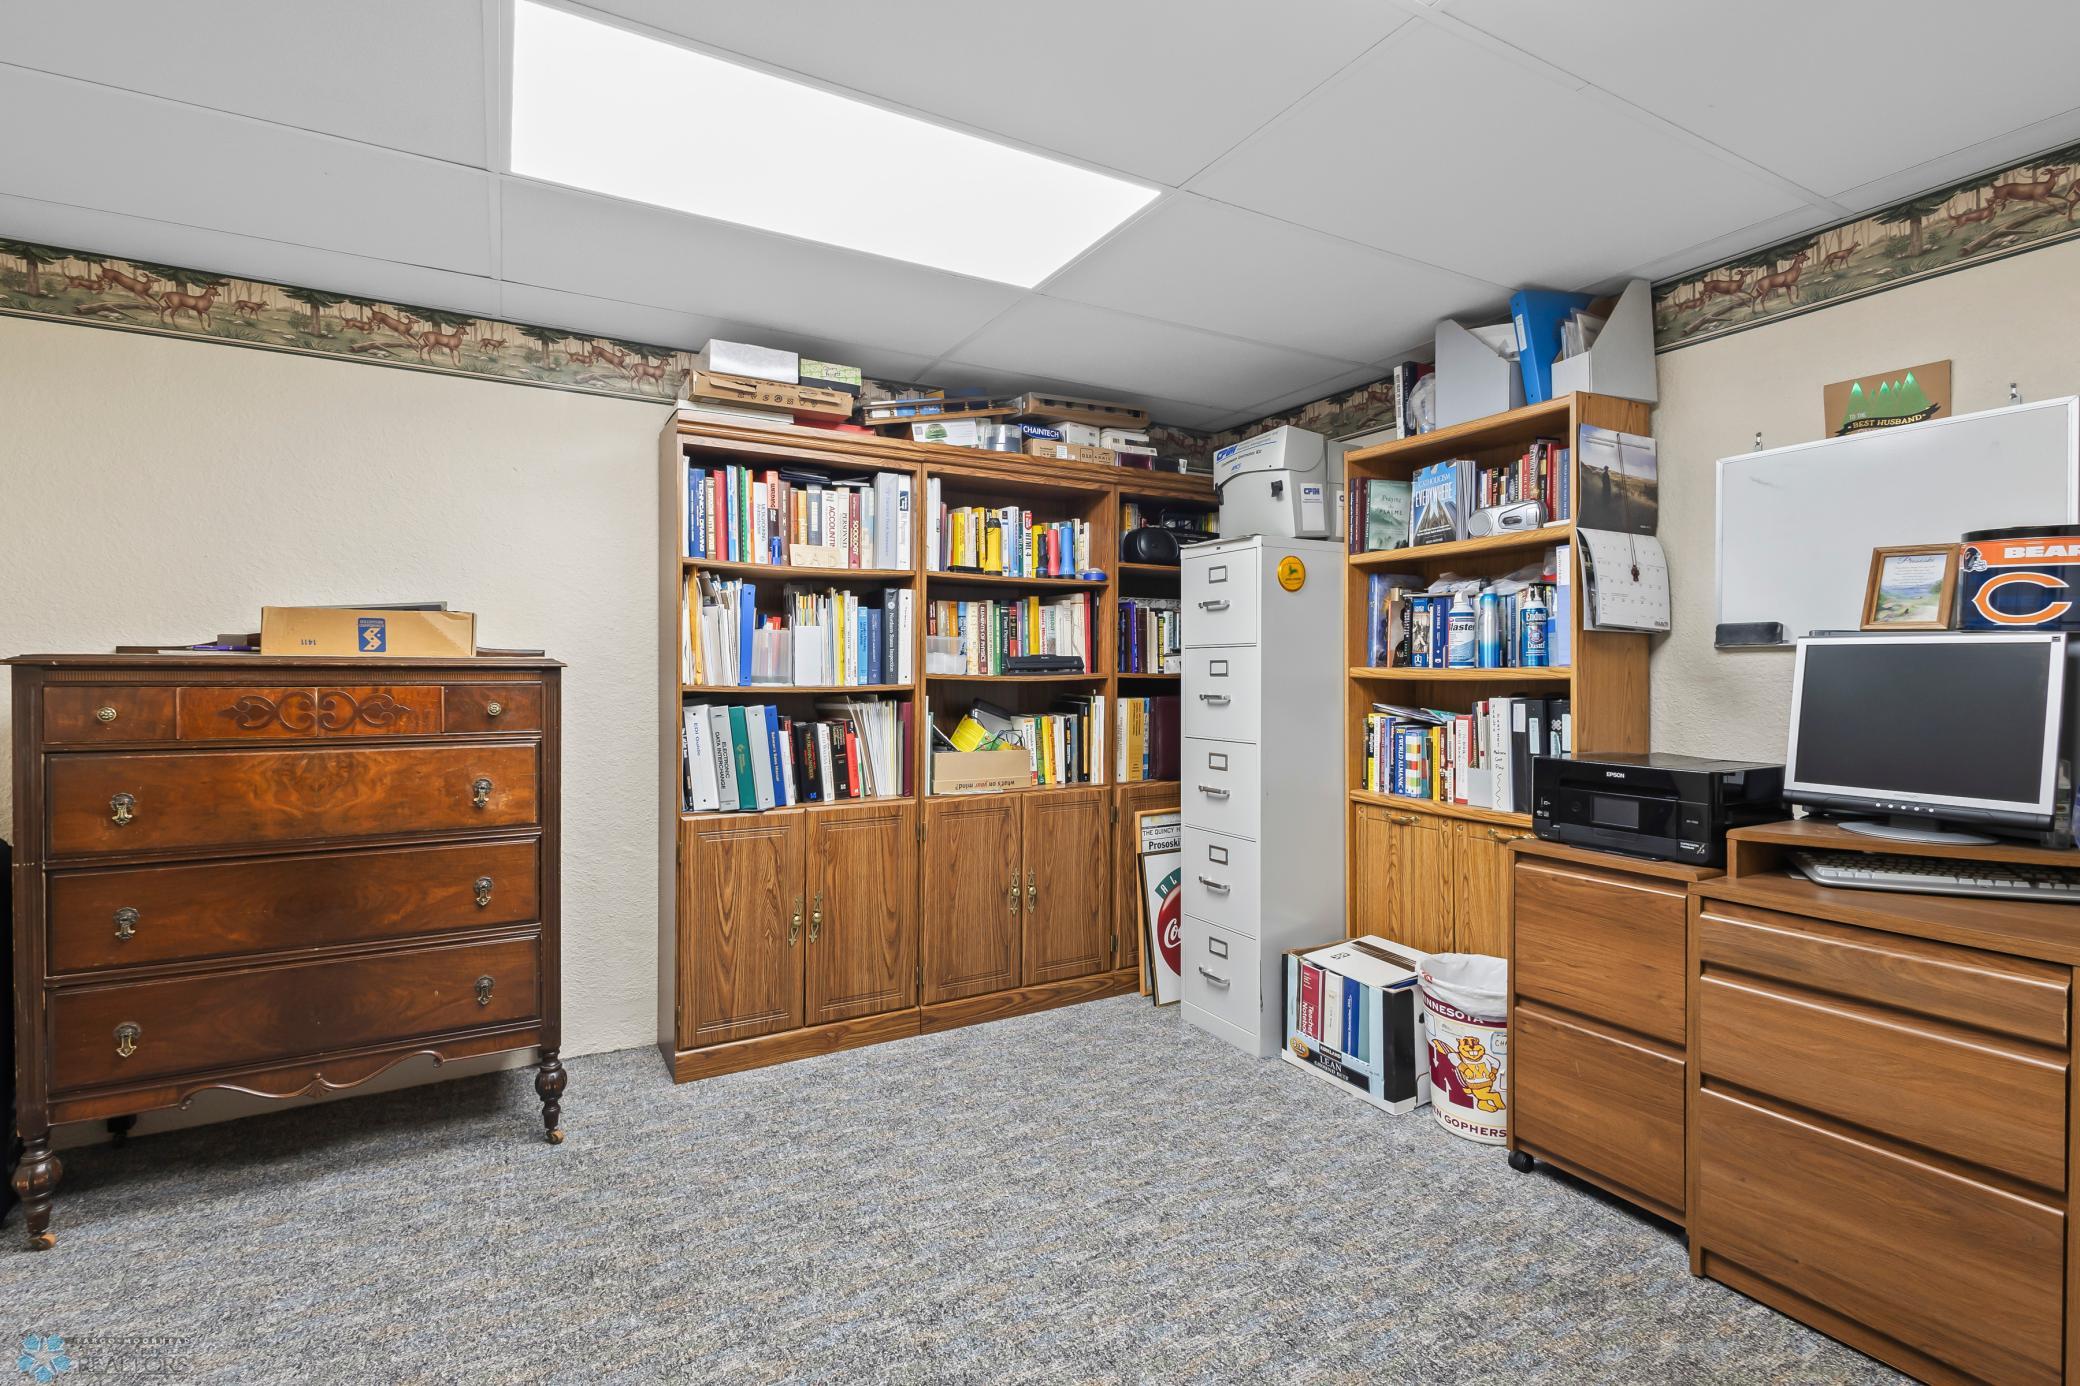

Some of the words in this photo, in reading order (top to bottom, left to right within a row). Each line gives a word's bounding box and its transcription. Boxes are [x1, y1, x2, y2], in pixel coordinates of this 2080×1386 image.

[1852, 419, 1875, 429] BEST
[1876, 414, 1922, 426] HUSBAND
[1023, 425, 1060, 439] CHAINTECH
[852, 520, 860, 555] SOCIOLOGY
[1449, 622, 1475, 631] laster
[1001, 629, 1009, 654] Physiology
[887, 649, 896, 672] Inspection
[714, 731, 722, 747] DATA
[715, 748, 726, 790] INTERCHANGE
[721, 741, 731, 779] ELECTRONIC
[997, 780, 1015, 788] what's
[1606, 771, 1625, 779] EPSON
[1143, 829, 1153, 837] THE
[1154, 827, 1173, 836] QUINCY
[1301, 1000, 1309, 1035] Notebo
[1306, 1005, 1315, 1037] Teacher
[1320, 1055, 1342, 1073] LEAN
[1444, 1114, 1507, 1138] GOPHERS
